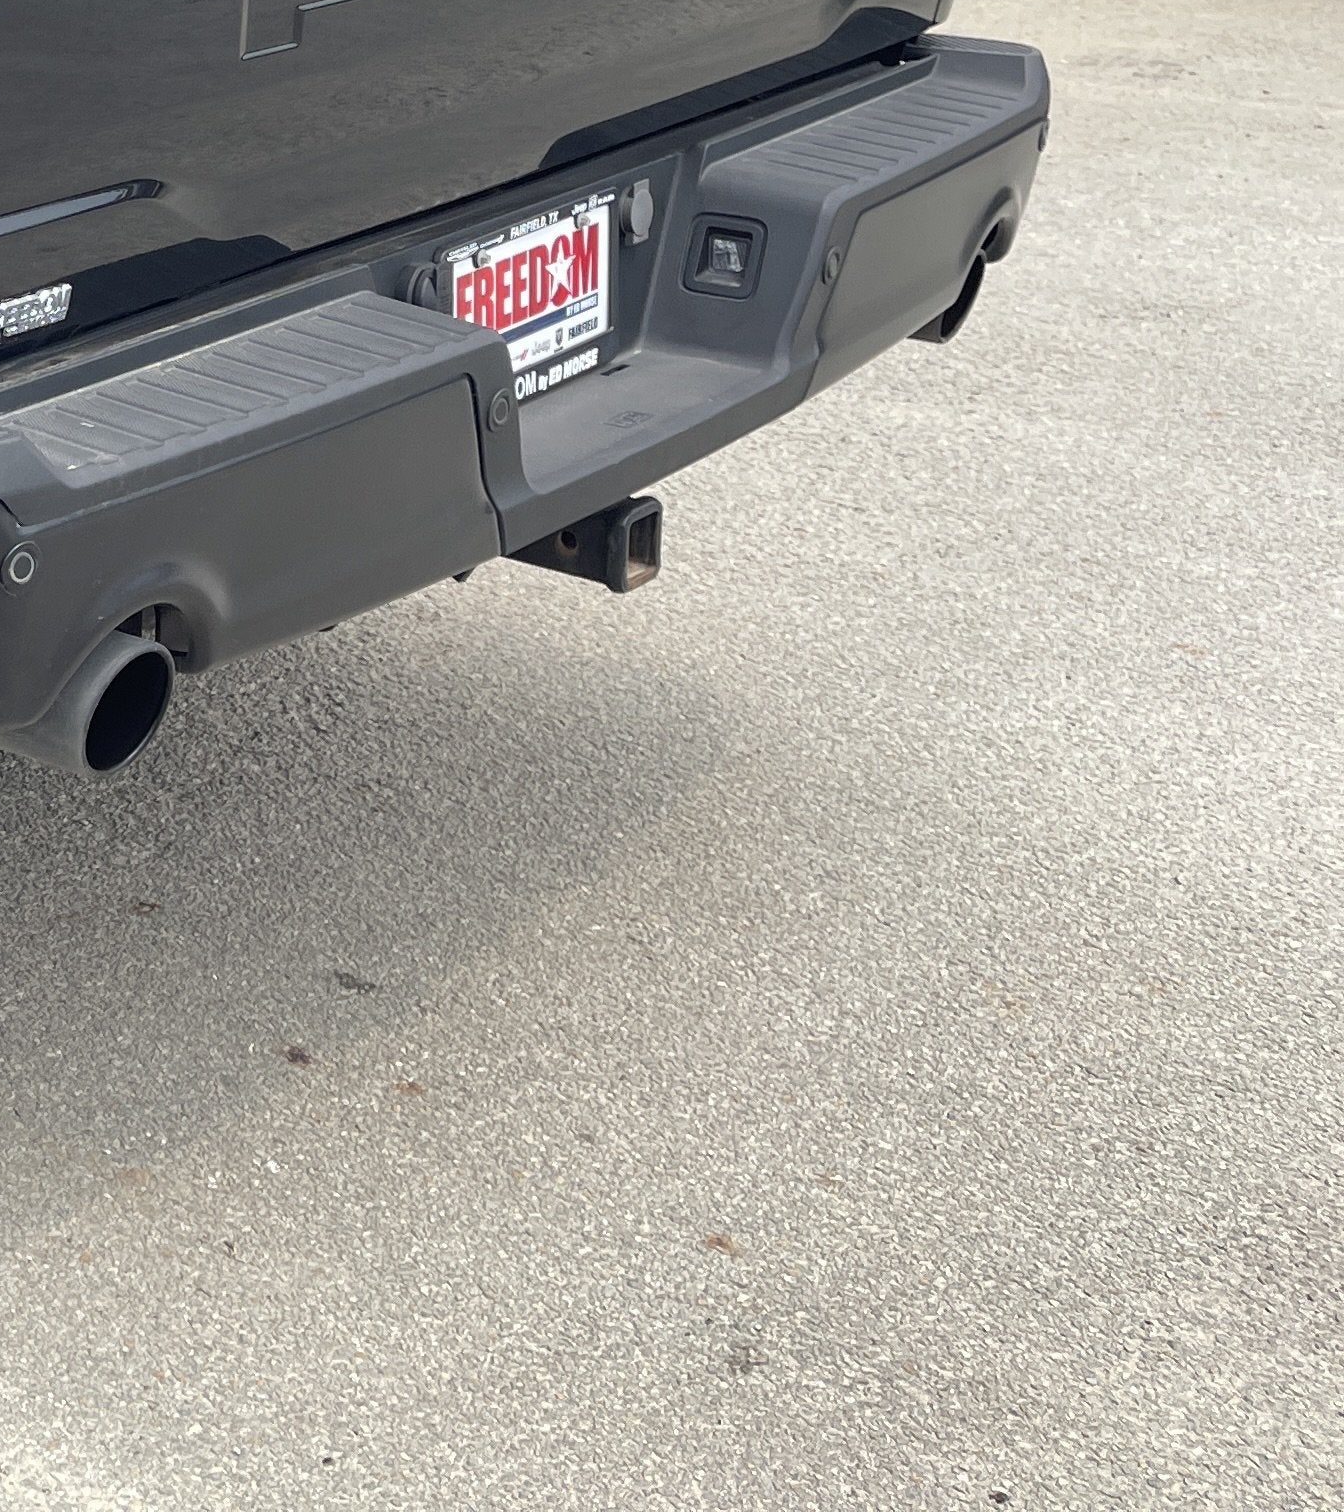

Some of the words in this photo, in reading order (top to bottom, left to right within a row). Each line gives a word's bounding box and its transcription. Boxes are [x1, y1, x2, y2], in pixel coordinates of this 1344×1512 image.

[548, 210, 559, 226] TX
[456, 223, 599, 331] FREEDOM
[548, 364, 563, 386] ED
[563, 347, 599, 380] MORSE
